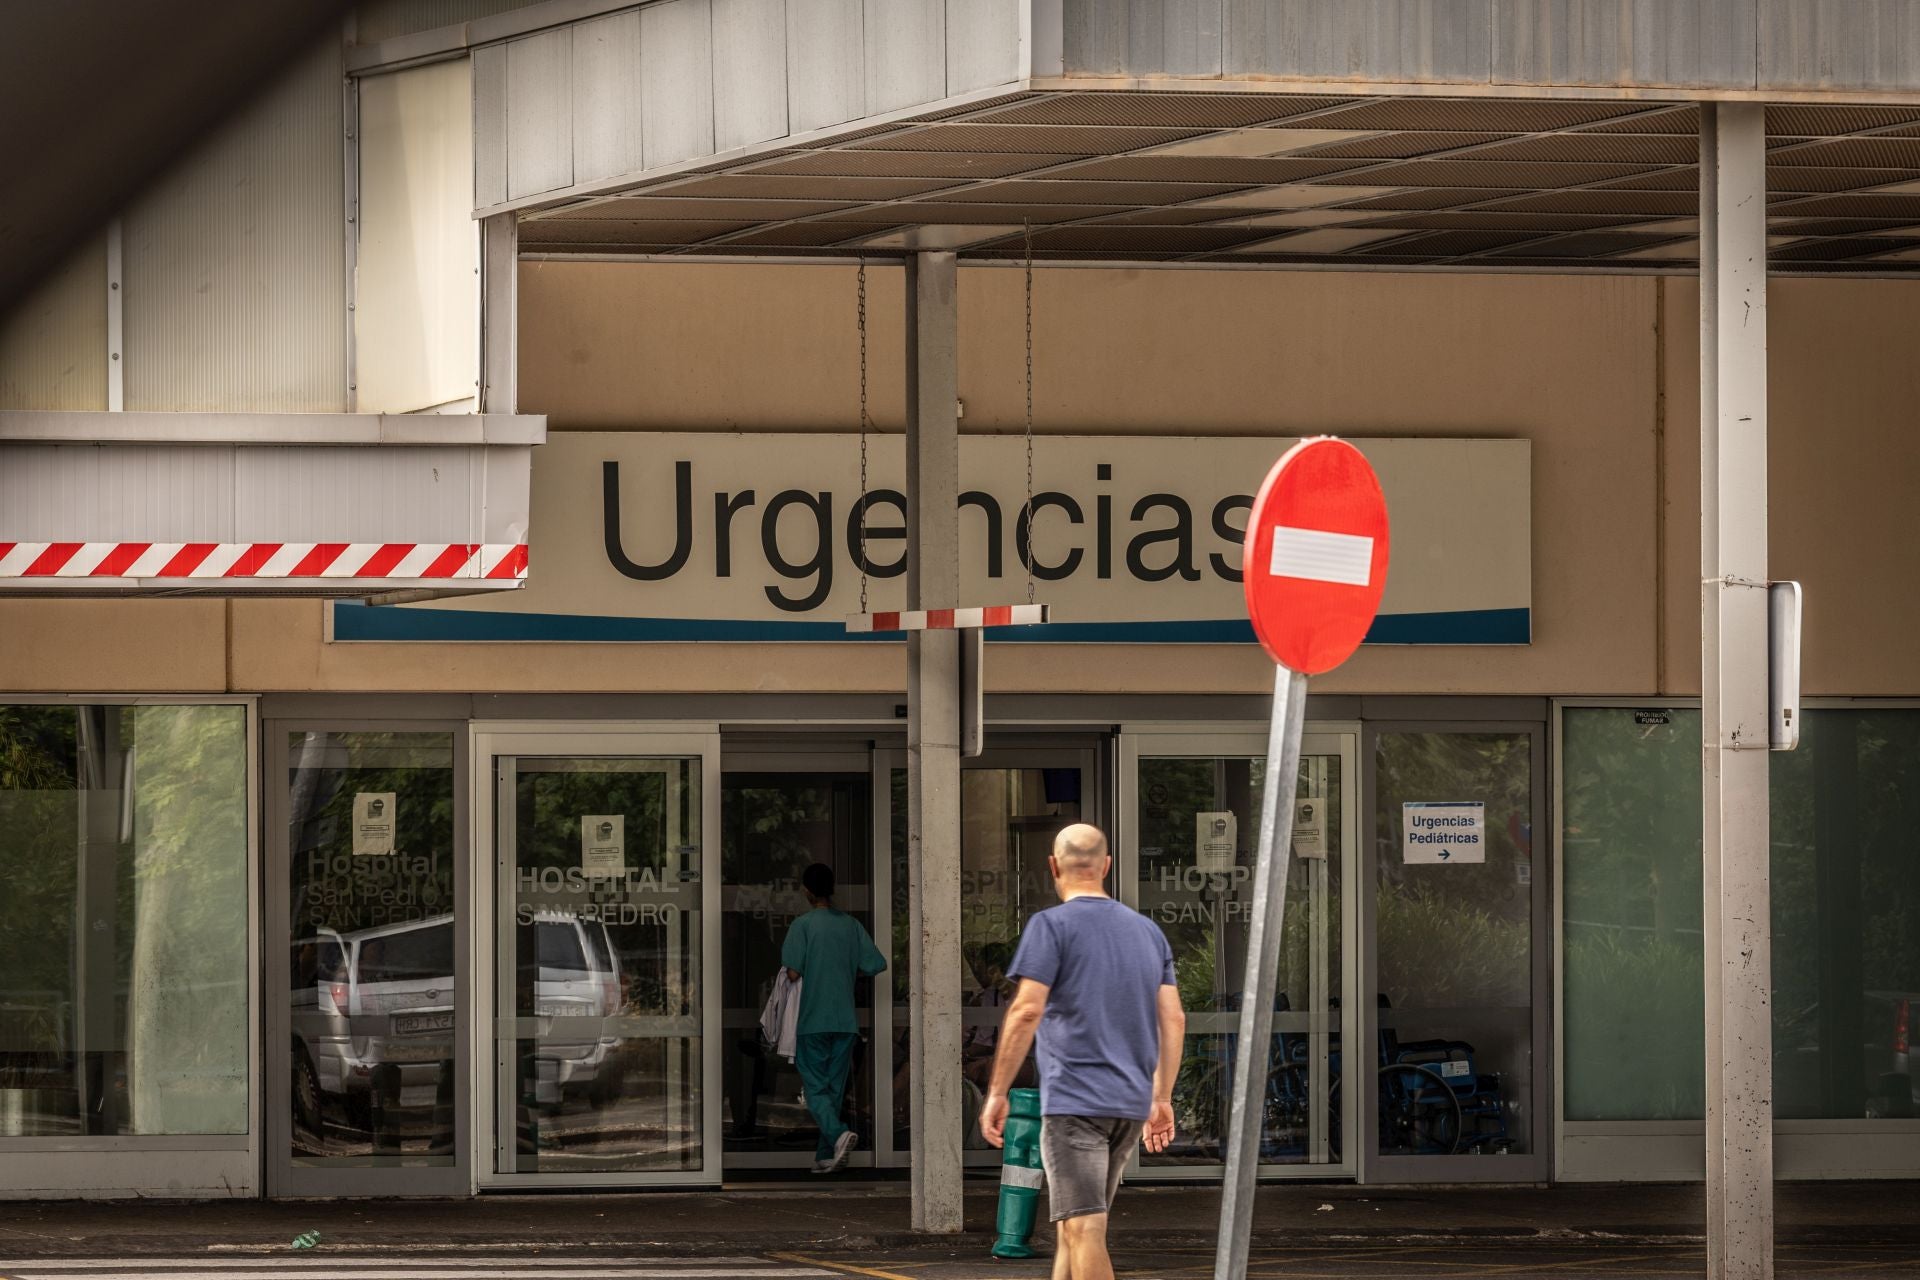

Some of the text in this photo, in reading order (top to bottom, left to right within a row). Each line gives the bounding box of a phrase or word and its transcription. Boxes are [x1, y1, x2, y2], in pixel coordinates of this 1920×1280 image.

[1412, 815, 1475, 829] Urgencias
[1409, 831, 1479, 844] Pediátricas
[308, 849, 438, 880] Hospital
[518, 867, 679, 893] HOSPITAL
[310, 905, 361, 927] SAN
[584, 903, 680, 926] PEDRO
[1160, 901, 1215, 924] SAN
